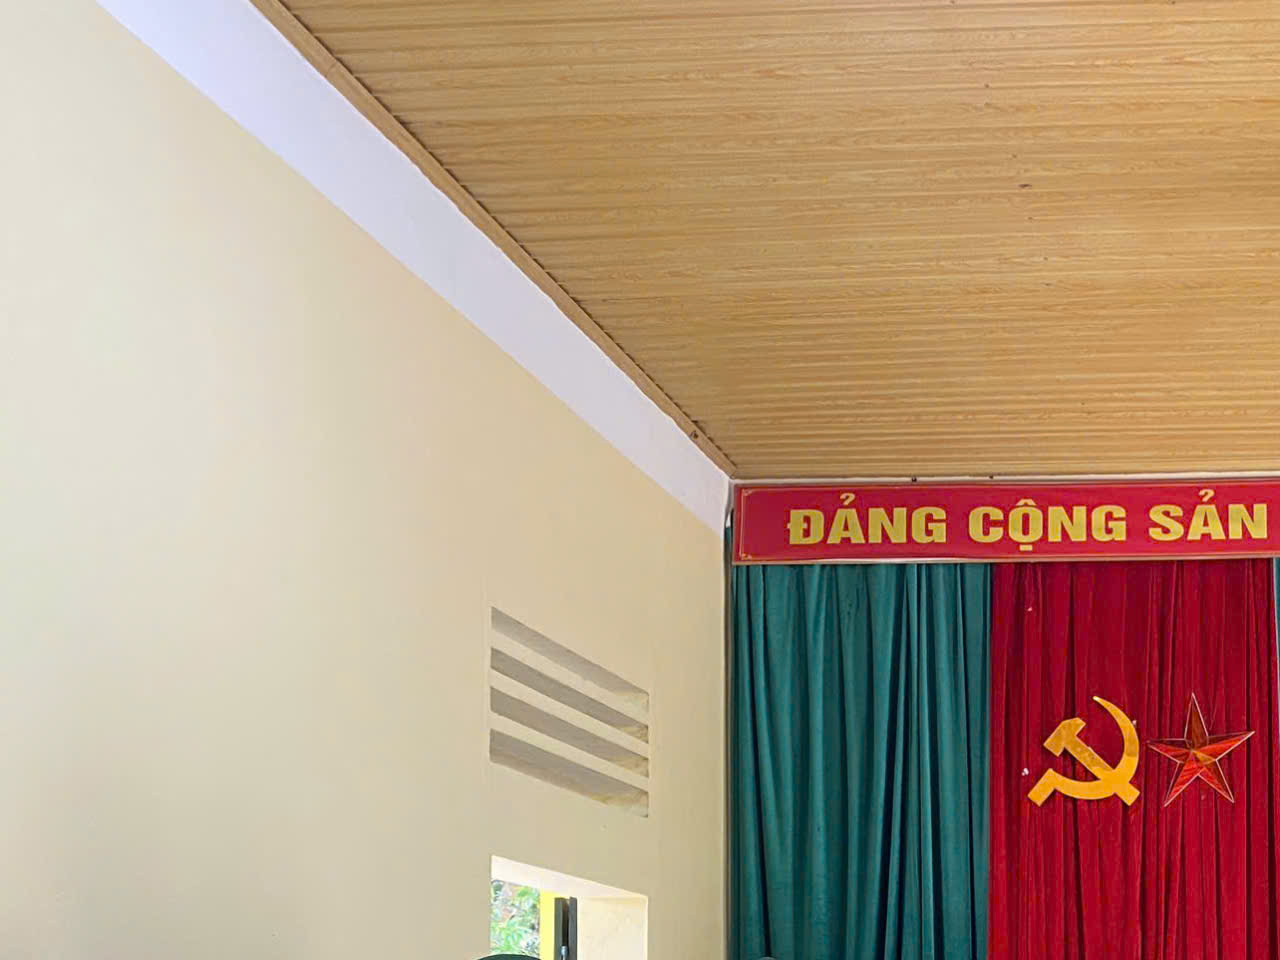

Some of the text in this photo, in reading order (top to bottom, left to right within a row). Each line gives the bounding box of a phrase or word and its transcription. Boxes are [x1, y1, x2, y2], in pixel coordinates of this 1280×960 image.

[788, 493, 946, 545] ĐẢNG
[968, 497, 1127, 552] CỘNG
[1149, 488, 1268, 540] SẢN
